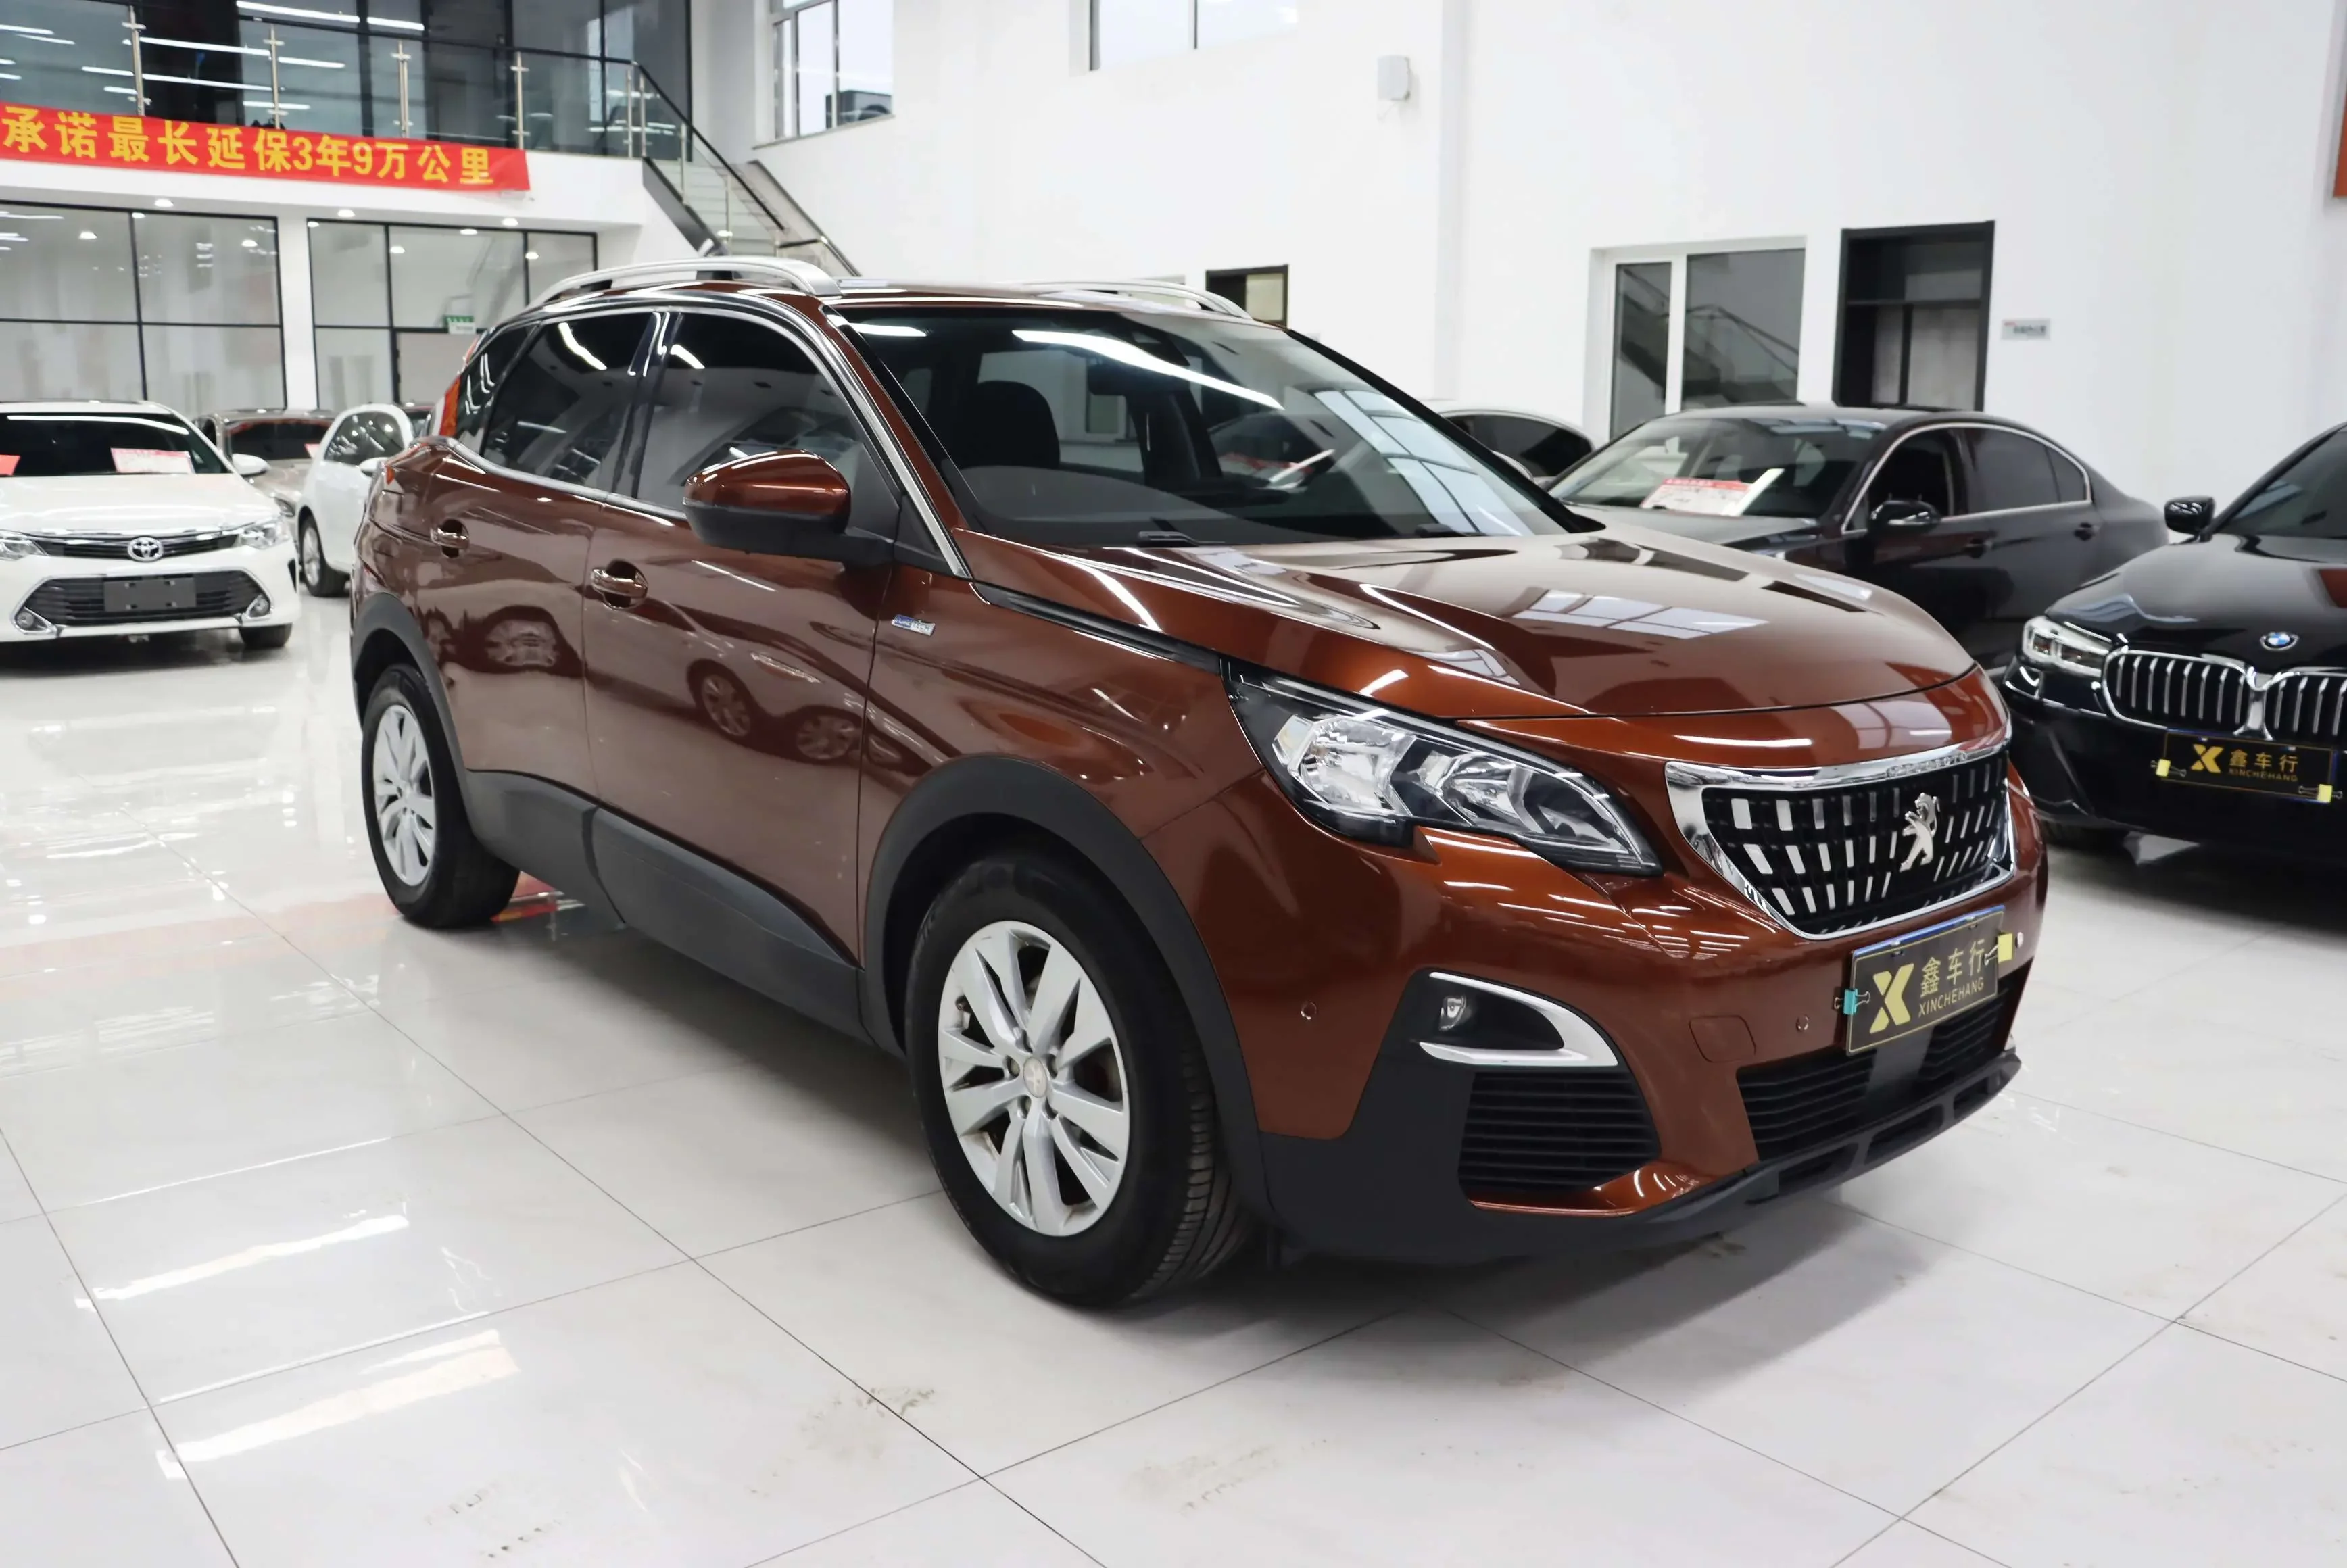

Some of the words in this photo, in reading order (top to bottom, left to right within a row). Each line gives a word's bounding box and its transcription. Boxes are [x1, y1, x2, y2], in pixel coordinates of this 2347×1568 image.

[1, 105, 494, 185] 承诺最长延保3年9万公里
[2229, 748, 2298, 773] 鑫车行
[1920, 938, 1985, 998] 鑫车行
[1918, 977, 1984, 1018] XINCHEHANG
